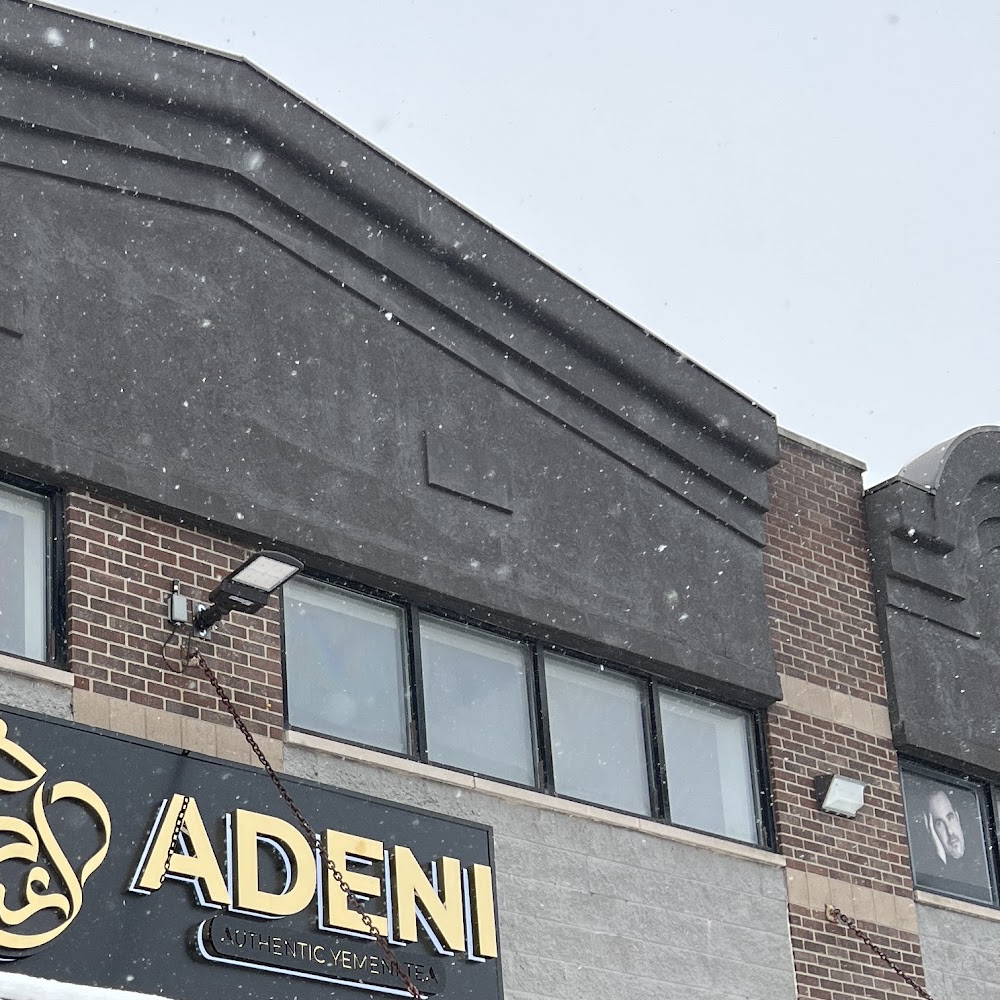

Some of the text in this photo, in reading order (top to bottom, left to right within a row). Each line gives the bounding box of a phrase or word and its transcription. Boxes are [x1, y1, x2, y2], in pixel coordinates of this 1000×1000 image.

[131, 793, 499, 961] ADENI
[220, 926, 326, 965] AUTHENTIC
[404, 961, 440, 985] TEA
